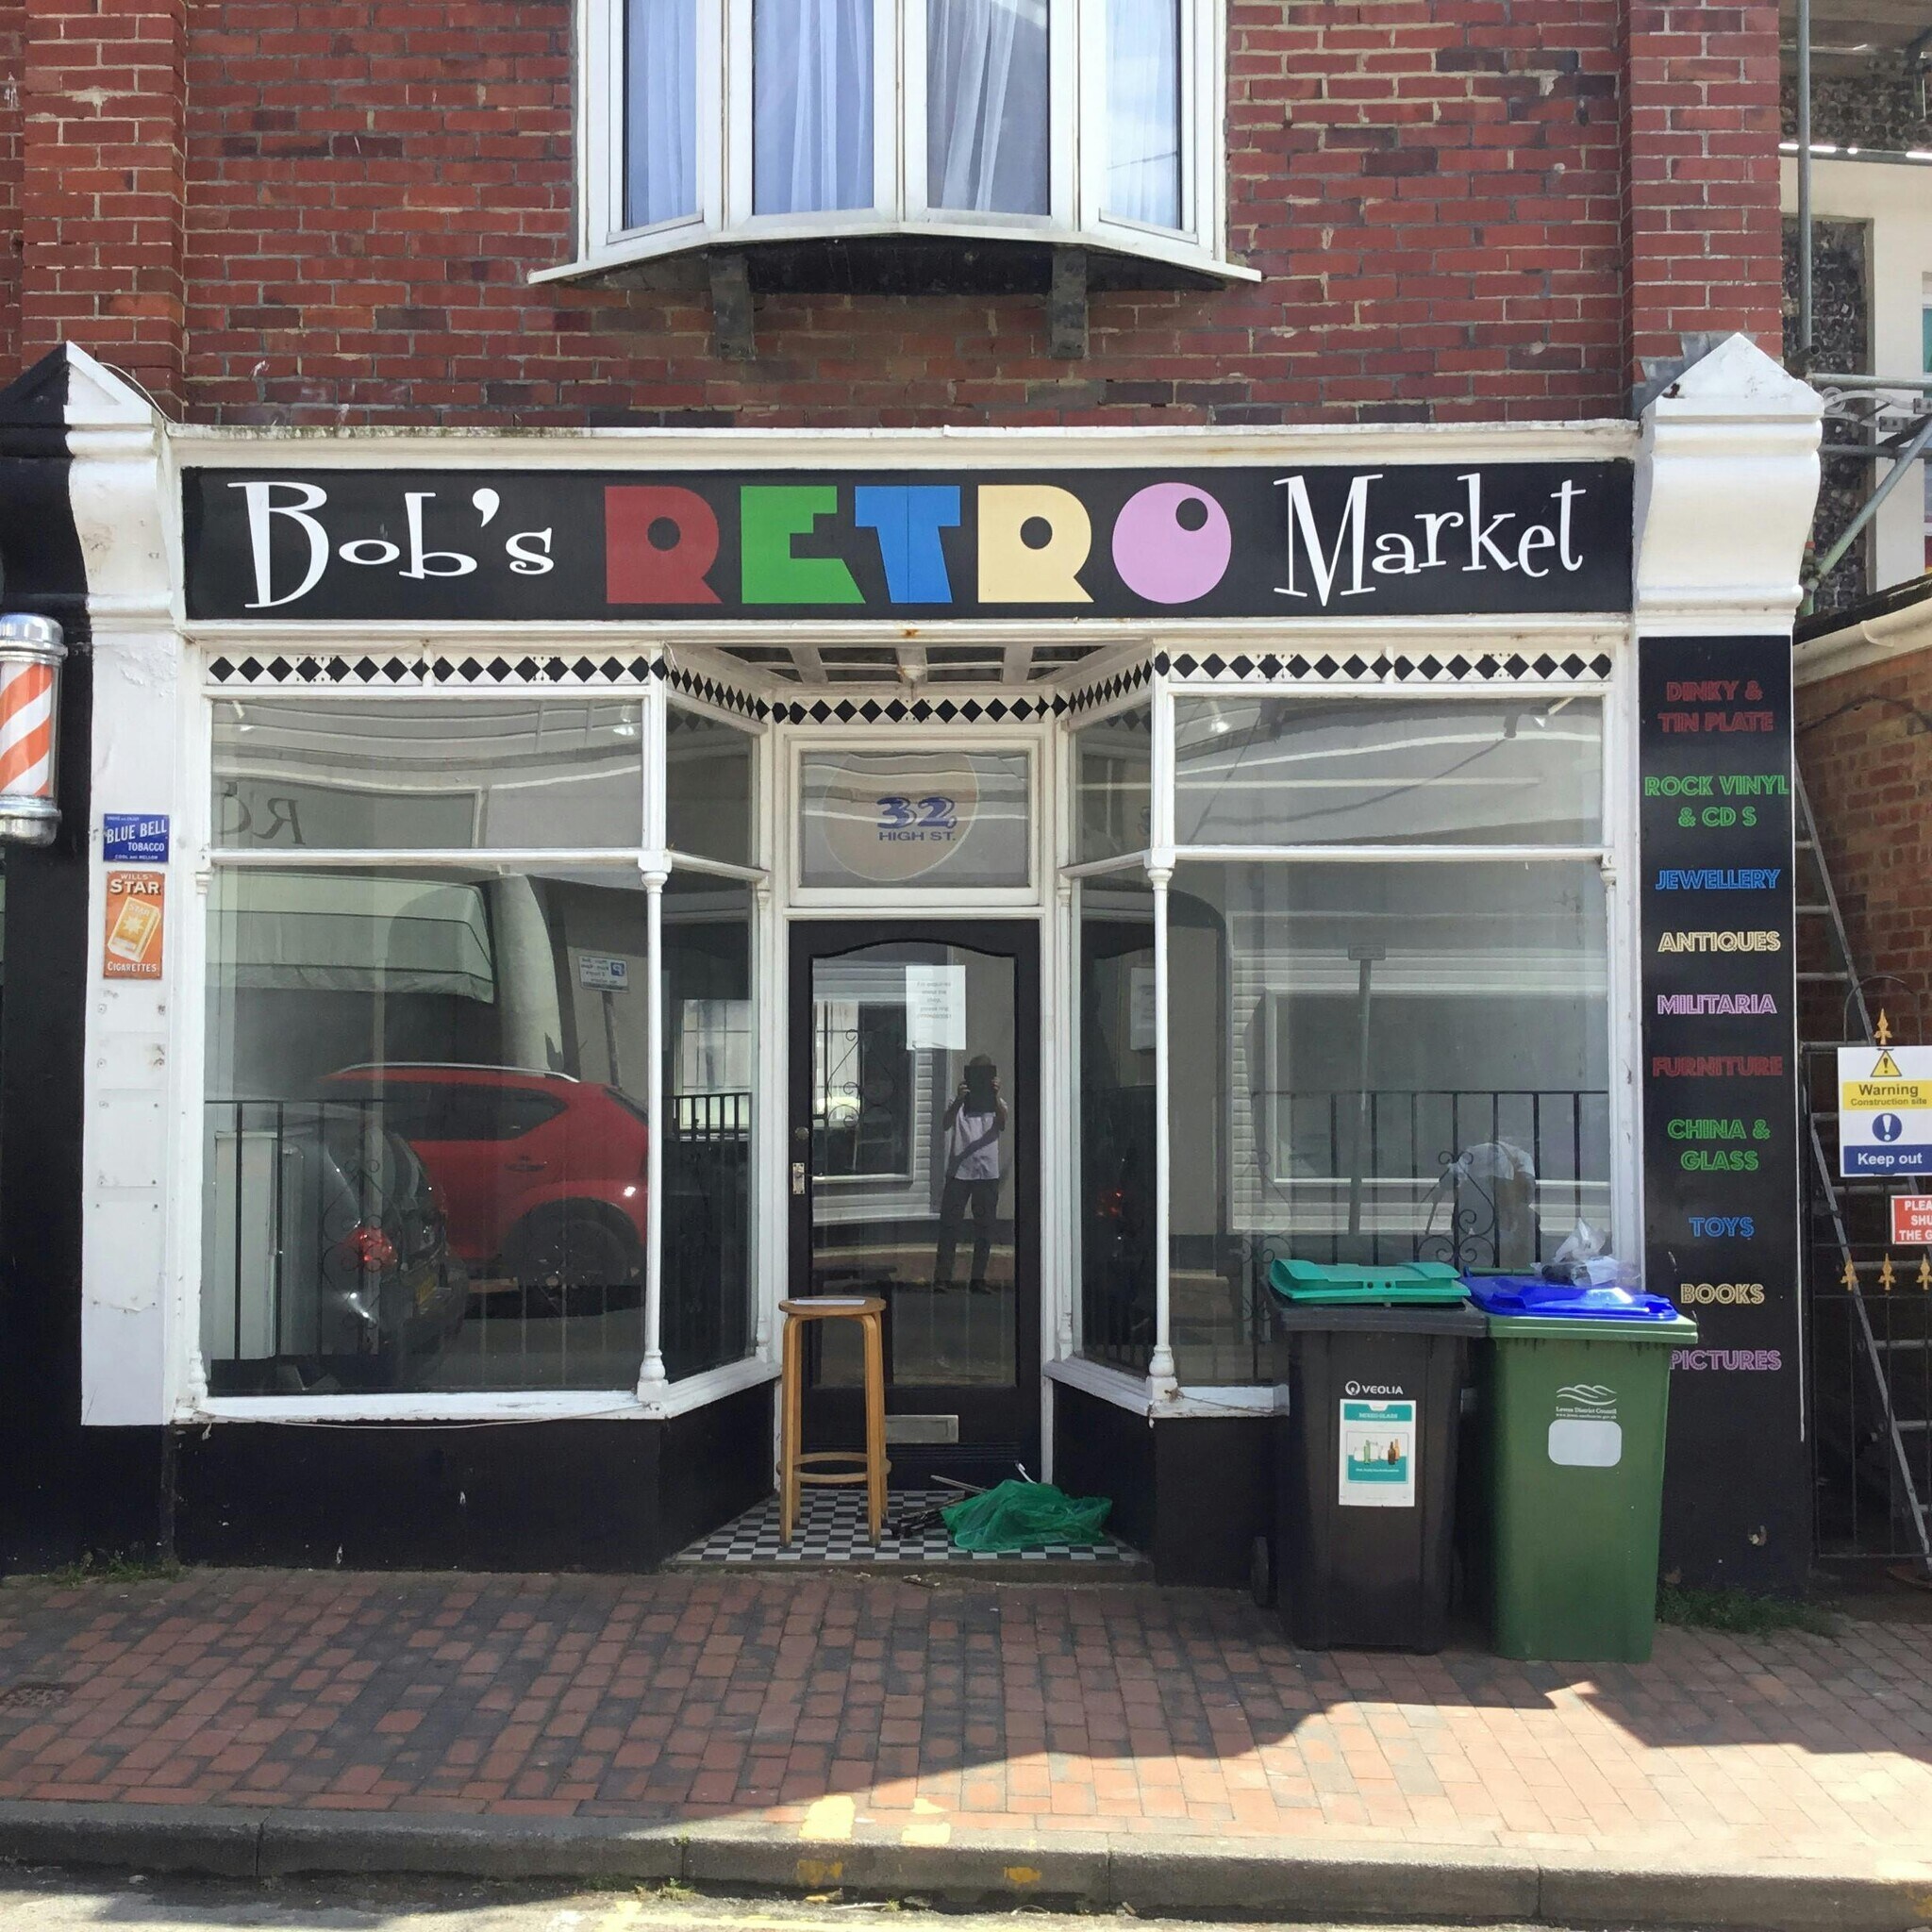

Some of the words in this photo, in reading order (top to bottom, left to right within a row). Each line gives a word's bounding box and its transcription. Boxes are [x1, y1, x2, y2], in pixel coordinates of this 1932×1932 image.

[227, 481, 555, 608] Bob's
[604, 481, 1232, 606] RETRO
[1273, 472, 1587, 607] Market
[1666, 680, 1739, 702] DINKY
[1743, 680, 1764, 701] &
[1657, 712, 1699, 733] TIN
[1704, 710, 1774, 732] PLATE
[1644, 775, 1714, 796] ROCK
[1719, 774, 1790, 795] VINYL
[876, 796, 958, 829] 32
[1677, 807, 1696, 827] &
[107, 824, 136, 844] BLUE
[140, 819, 167, 838] BELL
[878, 831, 924, 841] HIGH
[930, 831, 956, 841] ST.
[127, 841, 165, 852] TOBACCO
[109, 878, 160, 895] STAR
[1655, 869, 1781, 891] JEWELLERY
[1657, 931, 1781, 953] ANTIQUES
[1657, 994, 1777, 1015] MILITARIA
[1652, 1056, 1783, 1078] FURNITURE
[1850, 1097, 1908, 1107] Construction
[1910, 1096, 1927, 1106] site
[1858, 1084, 1919, 1099] Warning
[1667, 1119, 1746, 1140] CHINA
[1752, 1119, 1771, 1141] &
[1680, 1150, 1759, 1171] GLASS
[1857, 1153, 1895, 1168] Keep
[1898, 1153, 1923, 1165] out
[1689, 1216, 1755, 1238] TOYS
[1899, 1229, 1922, 1241] THE
[1680, 1283, 1765, 1305] BOOKS
[1671, 1350, 1782, 1371] PICTURES
[1361, 1385, 1404, 1395] VEOLIA
